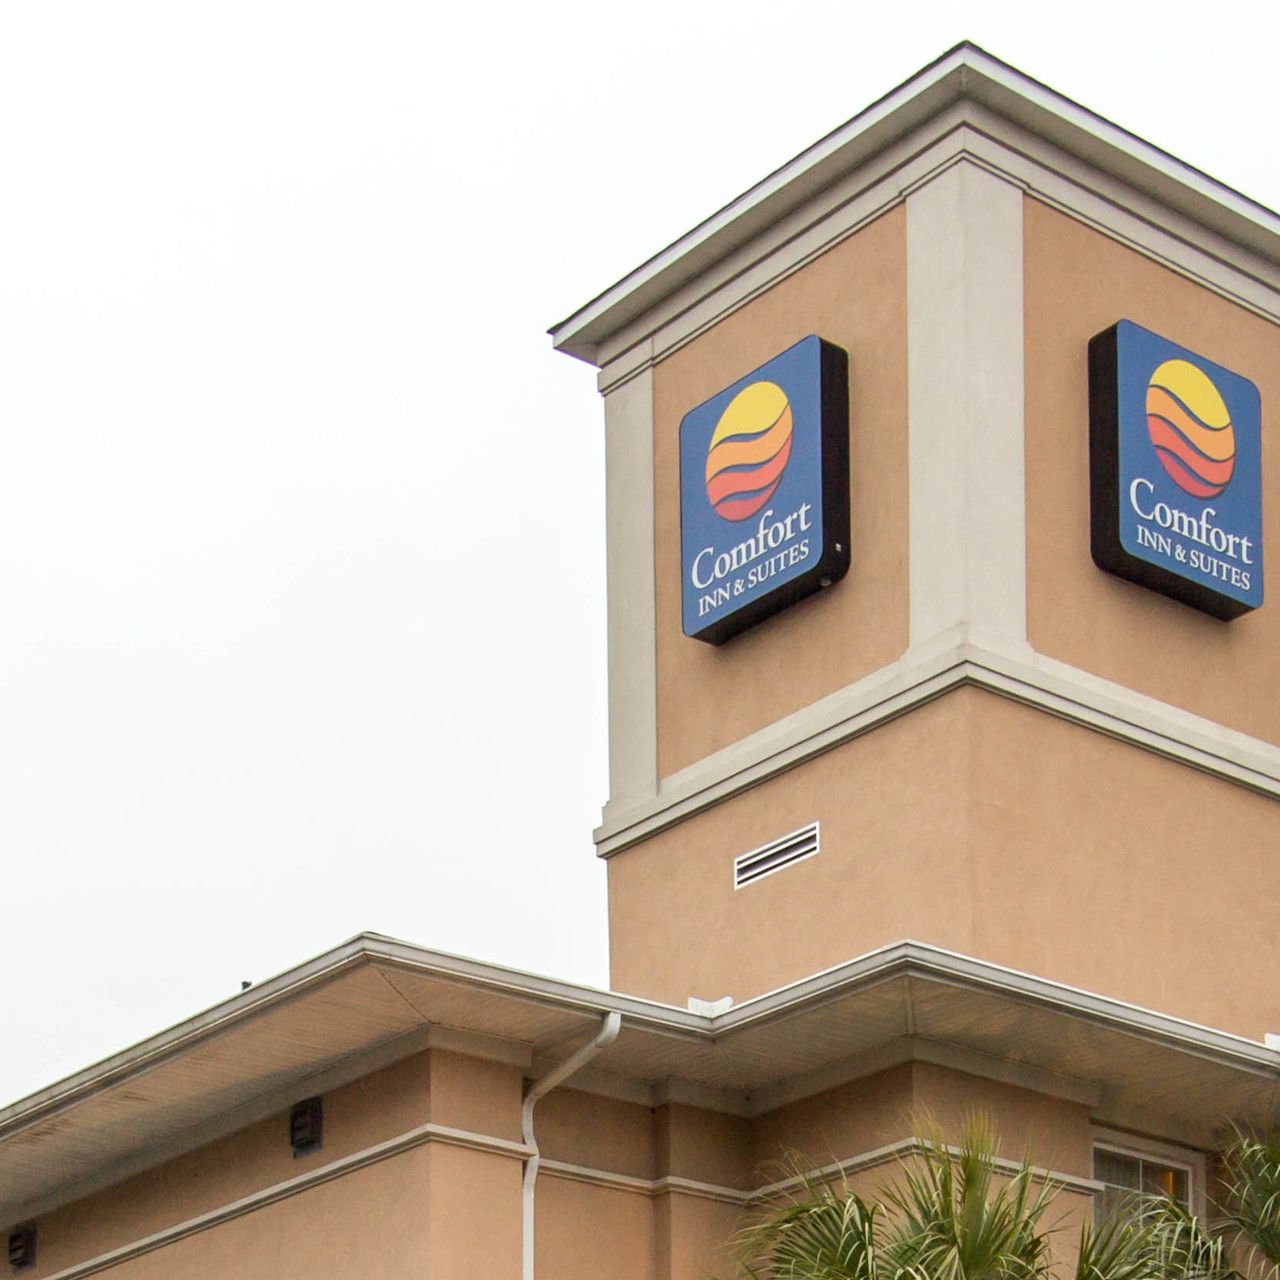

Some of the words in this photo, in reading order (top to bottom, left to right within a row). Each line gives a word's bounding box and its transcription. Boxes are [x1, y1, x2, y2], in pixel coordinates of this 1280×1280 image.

[692, 502, 812, 589] Comfort
[1130, 478, 1253, 564] Comfort
[1137, 524, 1173, 556] INN
[1174, 544, 1187, 563] &
[1189, 549, 1251, 591] SUITES
[698, 583, 732, 617] INN
[733, 577, 746, 597] &
[747, 538, 810, 588] SUITES
